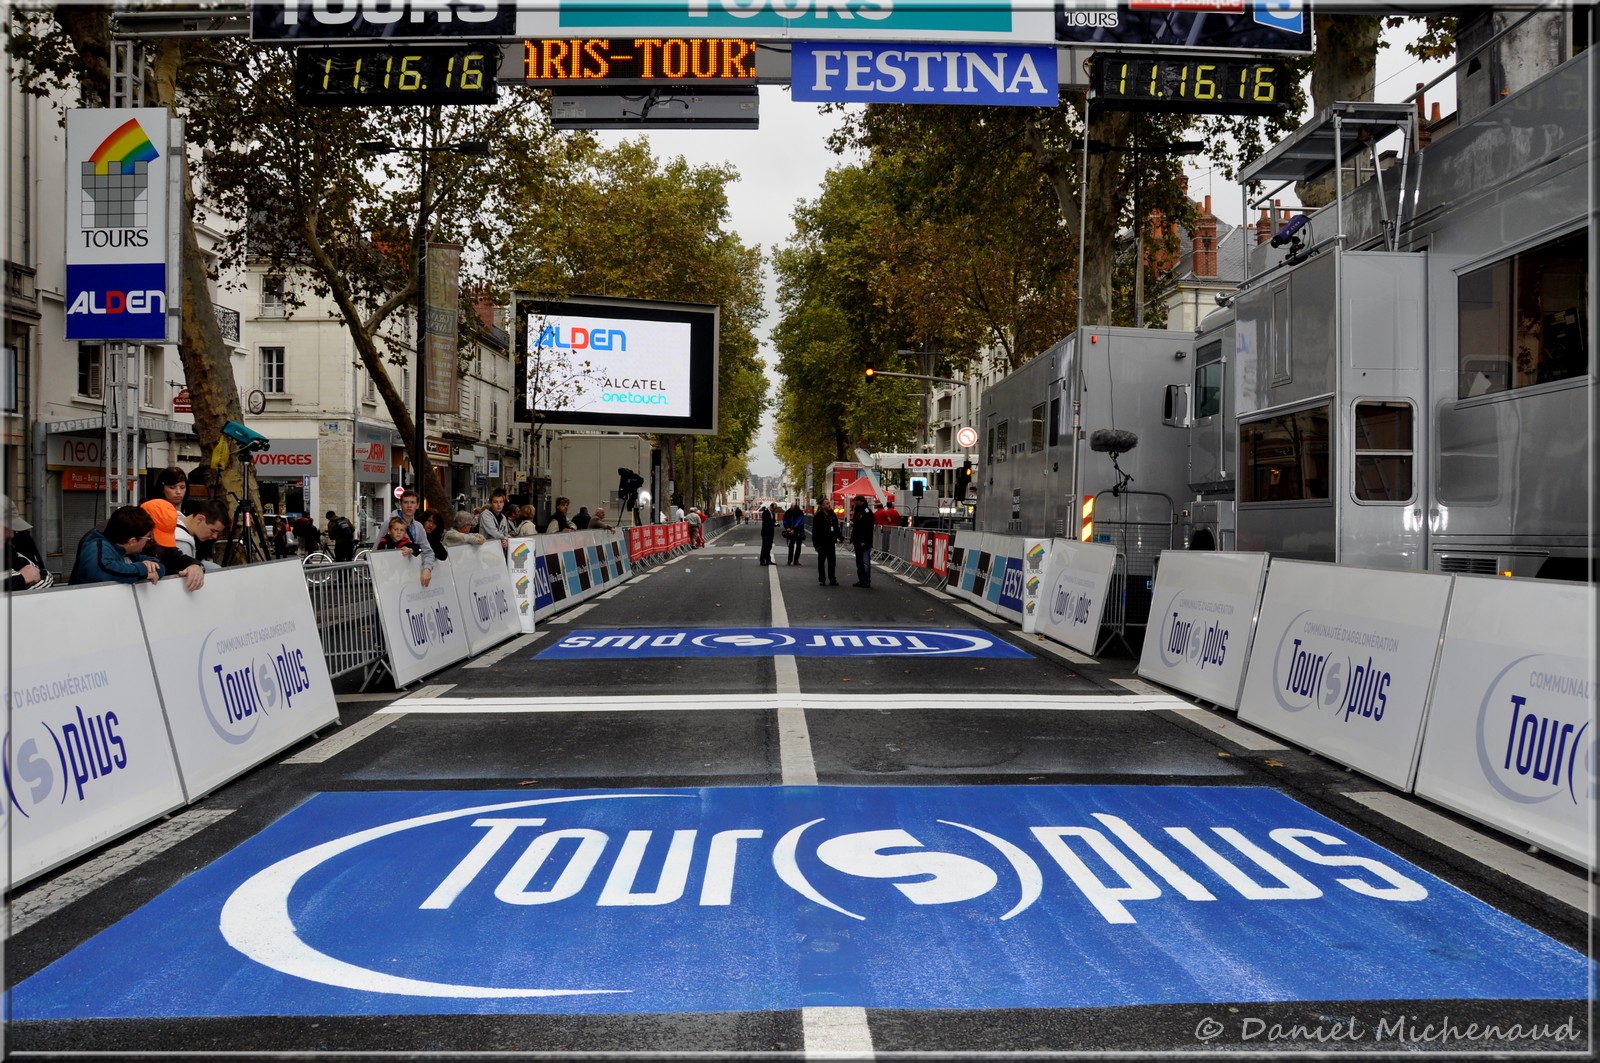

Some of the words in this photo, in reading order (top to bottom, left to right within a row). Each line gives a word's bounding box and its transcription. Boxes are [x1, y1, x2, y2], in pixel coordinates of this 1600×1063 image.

[1065, 12, 1118, 27] TOURS
[524, 39, 756, 78] ARIS-TOUR
[811, 49, 1048, 94] FESTINA
[81, 229, 149, 248] TOURS
[67, 290, 166, 315] ALDEN
[533, 325, 627, 351] ALDEN
[603, 378, 666, 391] ALCATEL
[63, 440, 98, 462] neo
[253, 454, 312, 465] VOYAGES
[908, 458, 953, 467] LOXAM
[1002, 568, 1023, 600] FEST
[14, 670, 109, 709] D'AGGLOMÉRATION
